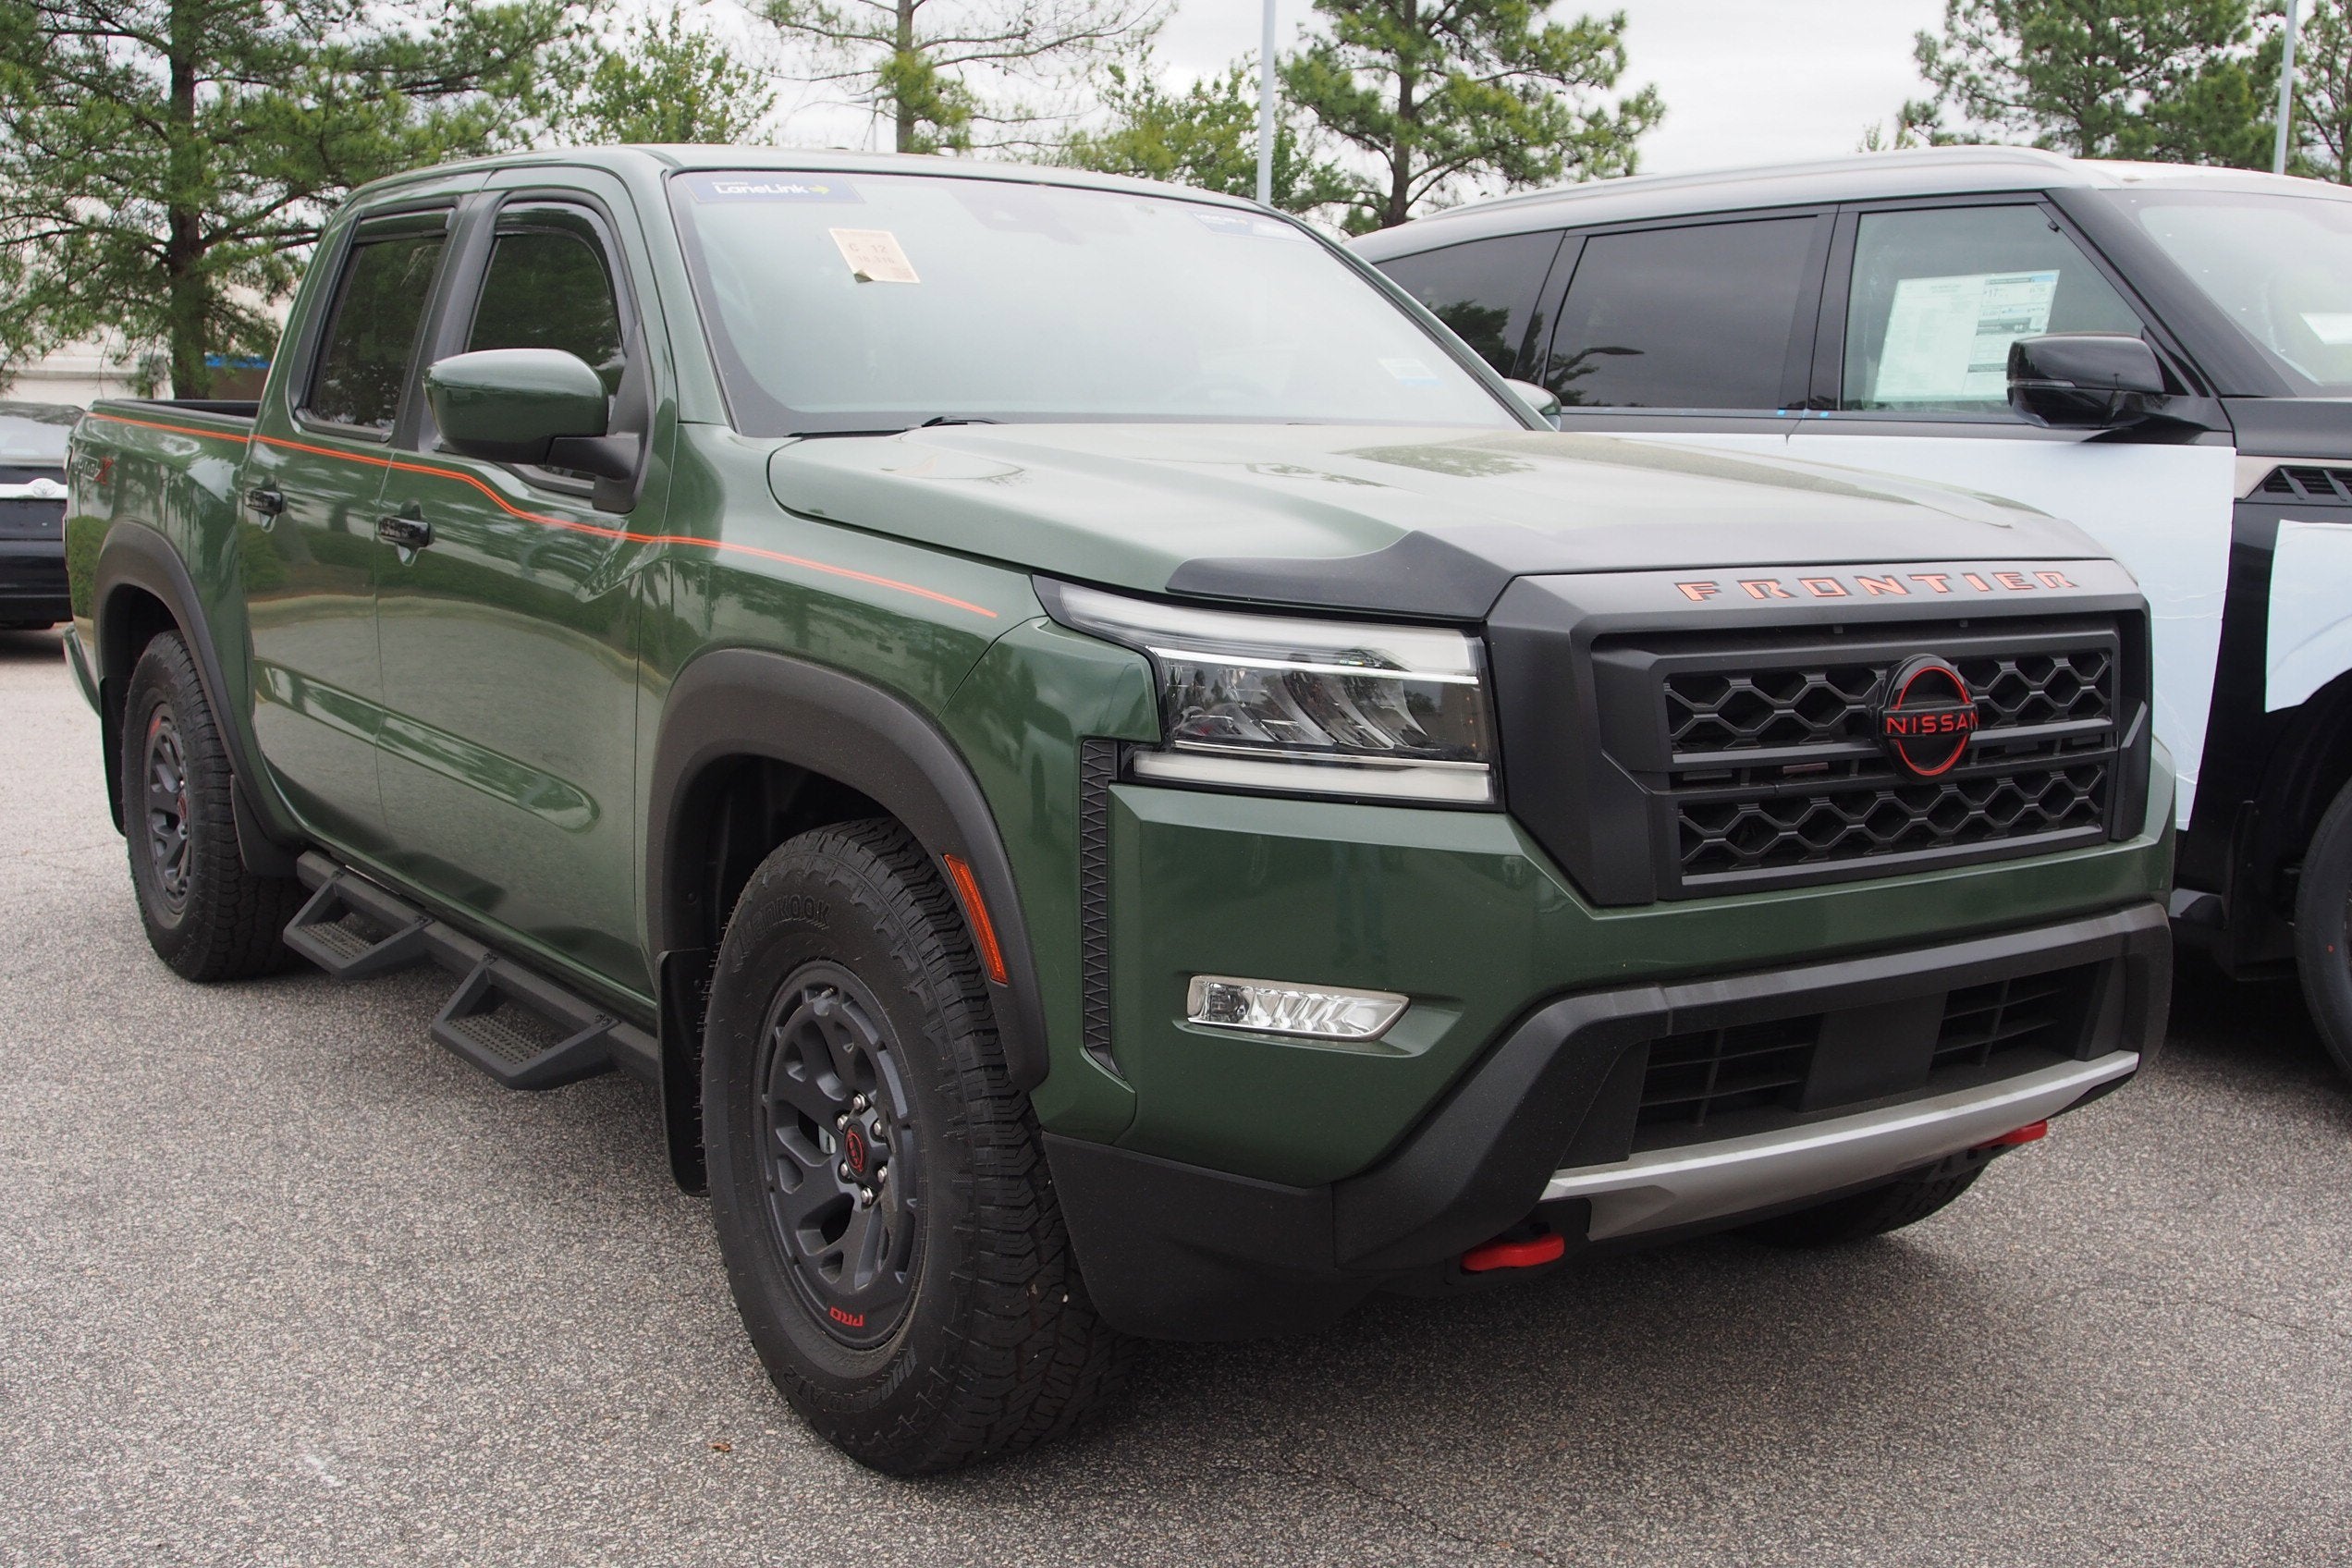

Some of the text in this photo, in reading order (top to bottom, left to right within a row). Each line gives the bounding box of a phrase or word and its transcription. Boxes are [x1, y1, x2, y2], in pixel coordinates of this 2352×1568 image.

[1674, 570, 2078, 601] FRONTIER
[1887, 712, 1978, 734] NISSAN
[829, 1305, 864, 1328] PRO
